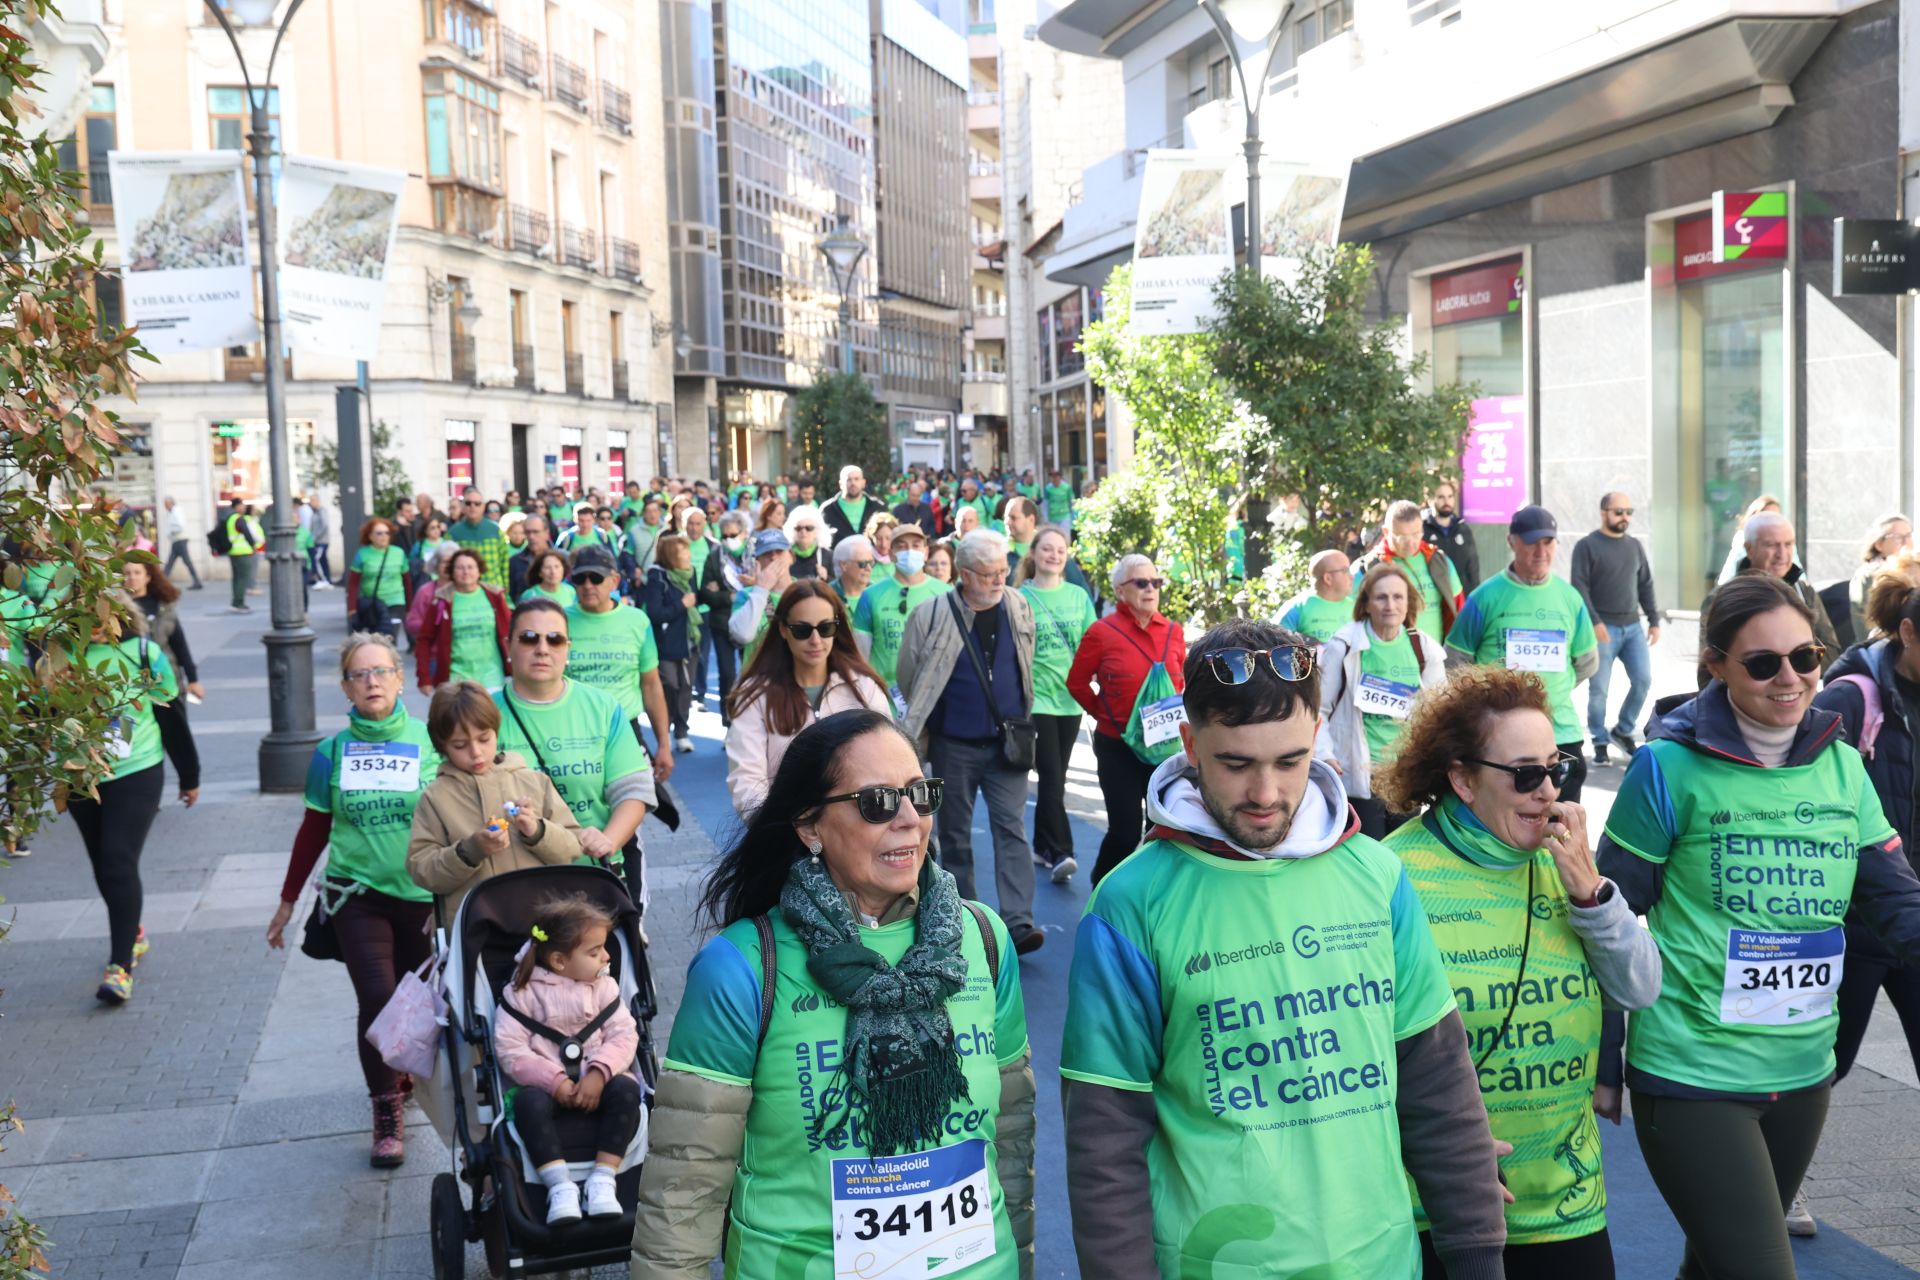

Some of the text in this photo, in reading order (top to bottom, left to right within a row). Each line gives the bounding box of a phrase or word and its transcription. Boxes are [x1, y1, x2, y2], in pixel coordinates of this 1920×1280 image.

[1843, 253, 1907, 264] SCALPERS
[1513, 644, 1560, 656] 36574
[1361, 689, 1408, 711] 36575
[1147, 709, 1184, 731] 26392
[349, 757, 411, 773] 35347
[345, 796, 406, 813] contra
[1733, 808, 1787, 823] Iberdrola
[369, 811, 413, 826] cánc
[1726, 833, 1765, 856] En
[1725, 863, 1825, 888] contra
[1726, 889, 1848, 917] el cáncer
[1428, 909, 1483, 925] Iberdrola
[1758, 935, 1802, 945] Valladolid
[1213, 939, 1286, 967] Iberdrola
[1447, 943, 1524, 965] Valladolid
[1738, 951, 1765, 959] contra
[1453, 963, 1599, 1012] n march
[1740, 962, 1831, 991] 34120
[1214, 972, 1394, 1034] En marcha
[1221, 1026, 1341, 1071] contra
[1196, 1003, 1227, 1118] VALLADOLID
[1228, 1074, 1269, 1111] el
[1253, 1119, 1297, 1132] VALLADOLID
[1298, 1118, 1310, 1126] EN
[1310, 1113, 1335, 1125] MARCHA
[1335, 1107, 1361, 1119] CONTRA
[1361, 1106, 1370, 1114] EL
[845, 1156, 930, 1176] XIV Valladolid
[846, 1174, 902, 1185] en marcha
[846, 1179, 931, 1195] contra el cáncer
[853, 1184, 979, 1241] 34118
